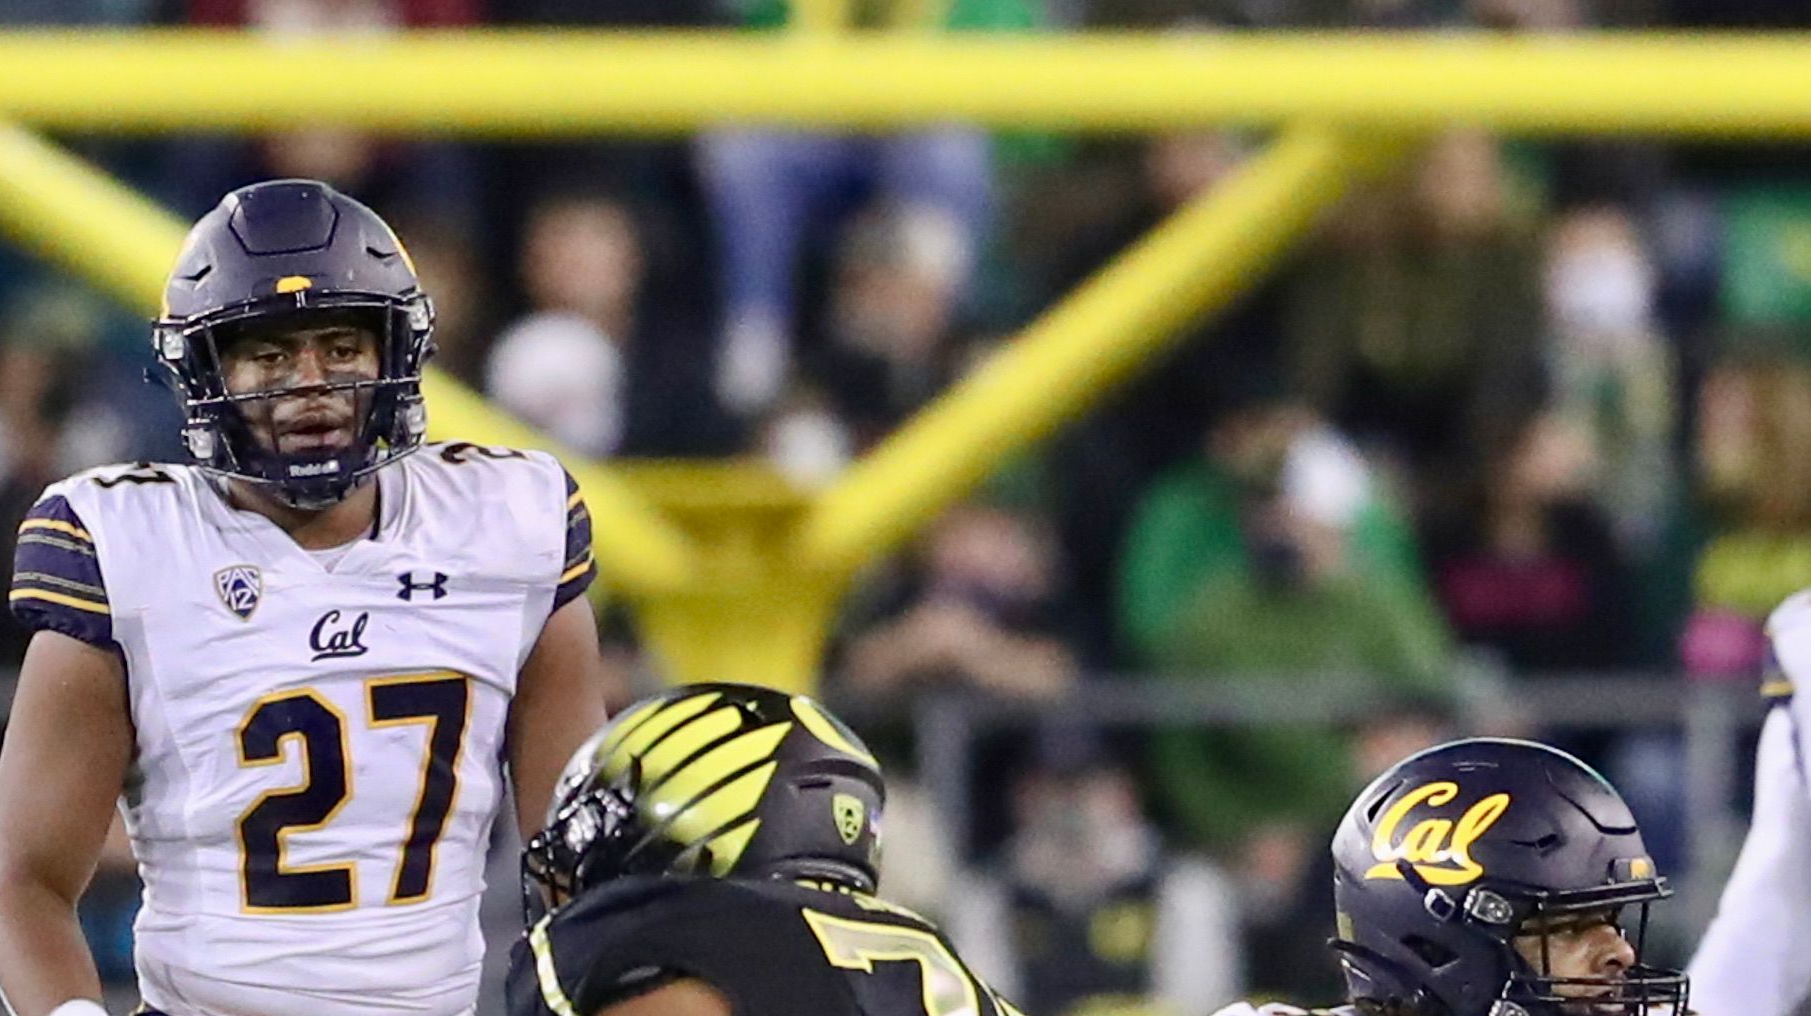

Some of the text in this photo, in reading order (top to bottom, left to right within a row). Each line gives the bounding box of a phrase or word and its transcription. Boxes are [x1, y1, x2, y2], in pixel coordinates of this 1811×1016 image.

[309, 609, 368, 662] Cal
[236, 671, 472, 914] 27
[1364, 781, 1510, 886] Cal
